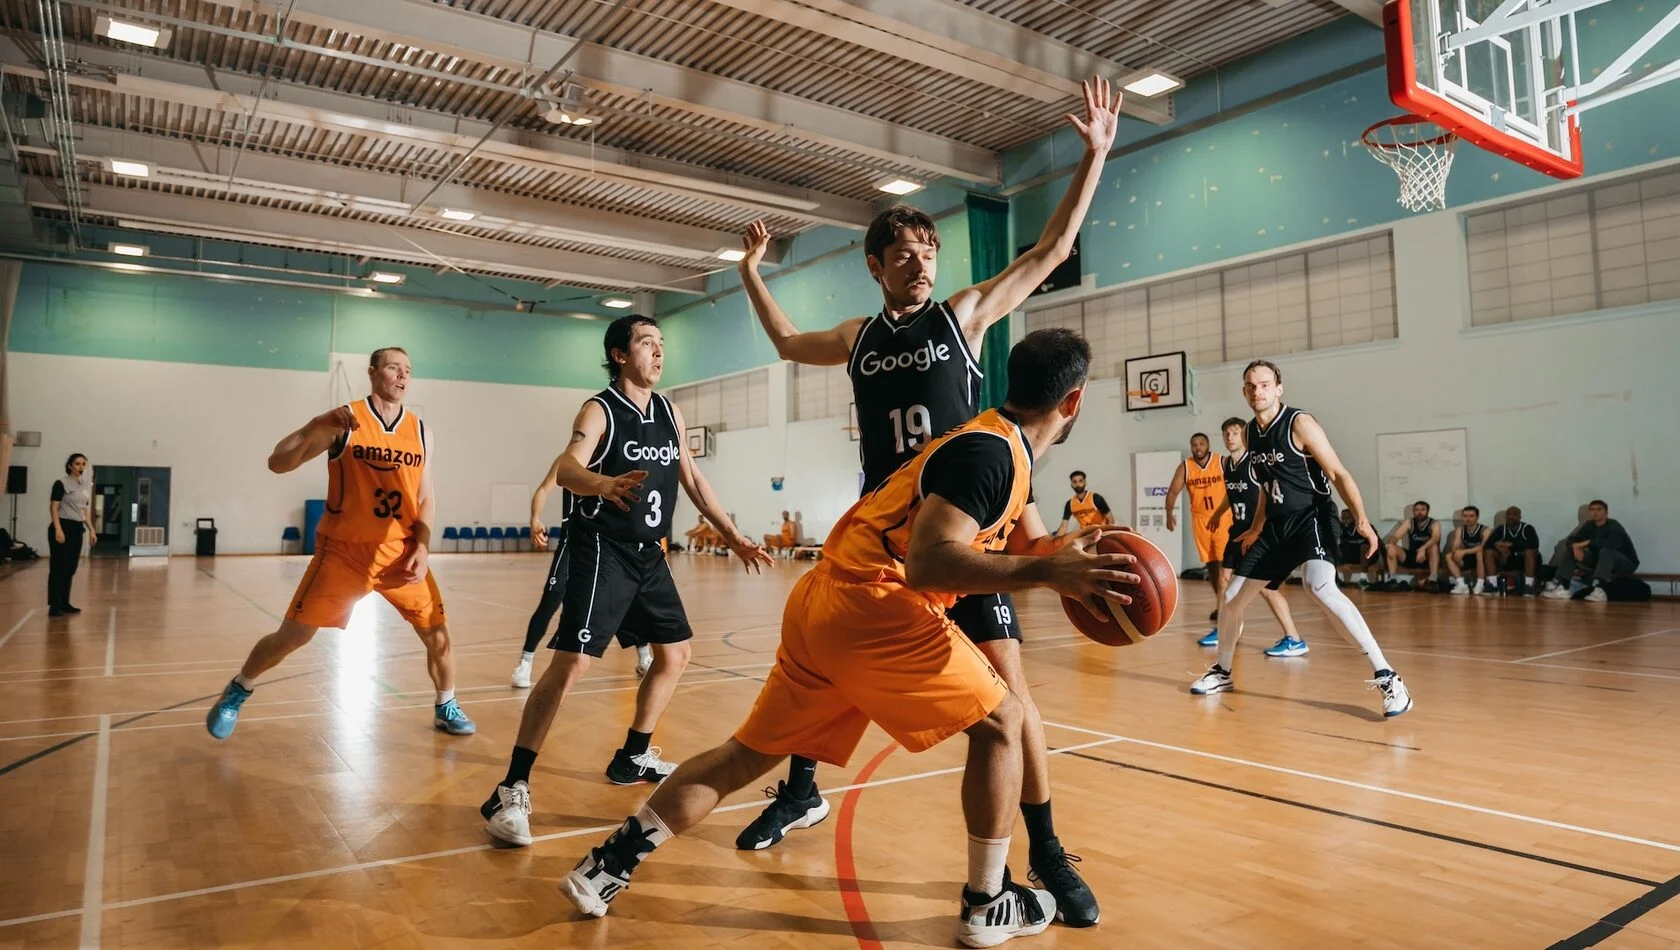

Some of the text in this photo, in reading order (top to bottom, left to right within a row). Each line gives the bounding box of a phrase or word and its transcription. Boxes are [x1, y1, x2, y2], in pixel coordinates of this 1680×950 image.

[860, 339, 951, 376] Google
[888, 404, 932, 454] 19
[352, 444, 422, 468] amazon
[623, 440, 680, 466] Google
[1250, 448, 1285, 466] Google
[374, 488, 402, 520] 32
[645, 490, 662, 528] 3
[1204, 496, 1214, 510] 11
[1315, 546, 1326, 556] 14
[549, 576, 557, 586] G
[993, 605, 1012, 625] 19
[578, 628, 592, 643] G
